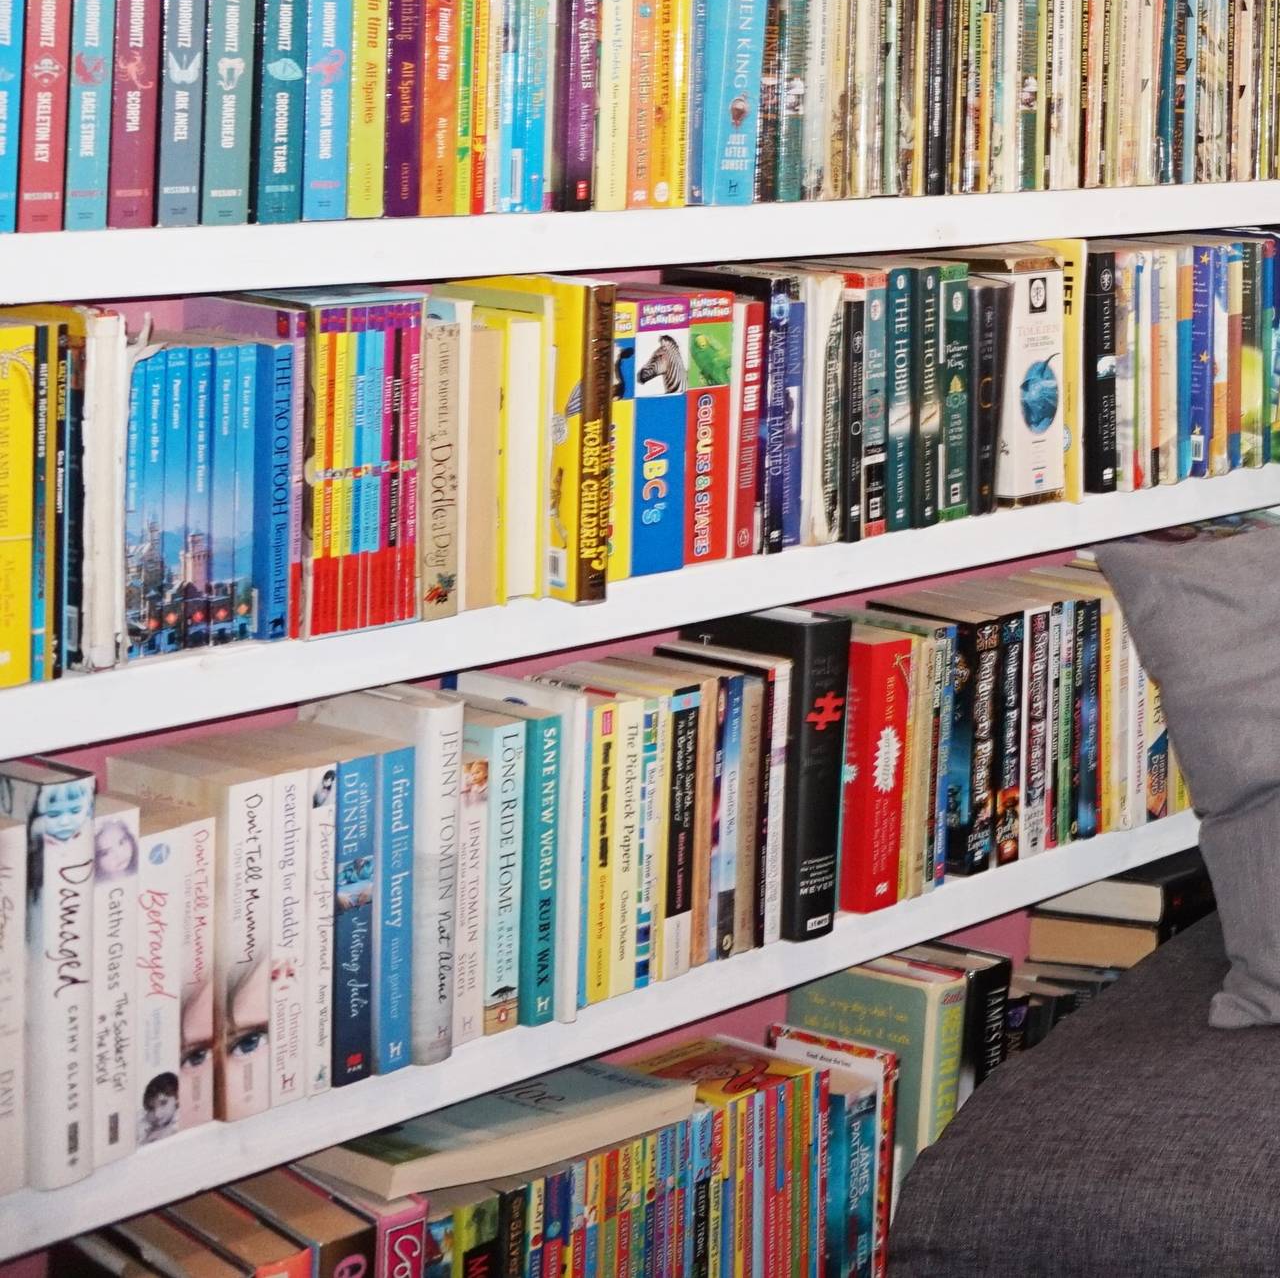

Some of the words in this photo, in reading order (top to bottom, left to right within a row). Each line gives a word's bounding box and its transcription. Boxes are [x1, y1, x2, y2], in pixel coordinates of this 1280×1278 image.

[40, 0, 57, 48] HOROWITZ
[366, 14, 381, 48] time
[579, 17, 593, 90] WRINKLIES
[732, 42, 751, 90] KING
[81, 91, 97, 122] EAGLE
[175, 90, 190, 113] ARK
[933, 76, 942, 101] Spike
[36, 91, 53, 142] SKELETON
[79, 125, 96, 159] STRIKE
[173, 115, 189, 143] ANGEL
[220, 94, 237, 149] SNAKEHEAD
[273, 92, 289, 143] CROCODILE
[727, 133, 749, 146] JUST
[932, 103, 942, 139] Milligan
[34, 143, 49, 163] KEY
[272, 145, 288, 175] TEARS
[721, 158, 750, 171] SUNSET
[725, 146, 749, 159] AFTER
[895, 294, 908, 328] THE
[1103, 297, 1111, 351] TOLKIEN
[275, 353, 292, 392] THE
[893, 330, 908, 407] HOBBIT
[275, 394, 291, 431] TAO
[692, 393, 714, 474] COLOURS
[273, 435, 290, 459] OF
[582, 419, 602, 476] WORST
[769, 416, 784, 475] HAUNTED
[272, 463, 289, 517] POOH
[578, 476, 601, 561] CHILDREN
[692, 490, 711, 557] SHAPES
[272, 522, 288, 577] Benjamin
[273, 579, 286, 604] Hoff
[540, 727, 558, 773] SANE
[626, 723, 640, 749] The
[438, 729, 461, 799] JENNY
[502, 732, 522, 795] LONG
[622, 752, 639, 821] Pickwick
[972, 740, 995, 802] Pleasant
[243, 793, 265, 842] Don't
[276, 783, 299, 870] searching
[342, 771, 360, 855] DUNNE
[390, 776, 413, 836] friend
[498, 799, 520, 849] RIDE
[540, 780, 556, 824] NEW
[243, 843, 263, 884] Tell
[436, 809, 458, 904] TOMLIN
[536, 828, 556, 893] WORLD
[619, 824, 636, 874] Papers
[279, 871, 296, 891] for
[386, 870, 409, 929] henry
[495, 850, 517, 918] HOME
[45, 858, 94, 999] Damaged
[106, 887, 125, 941] Cathy
[236, 886, 264, 965] Mummy
[276, 892, 296, 951] daddy
[436, 909, 452, 945] Not
[536, 896, 553, 941] RUBY
[106, 942, 124, 992] Glass
[136, 889, 177, 1000] Betrayed
[534, 945, 551, 988] WAX
[436, 949, 453, 1006] Alone
[849, 1120, 863, 1211] PATTERSON
[858, 1142, 872, 1196] JAMES
